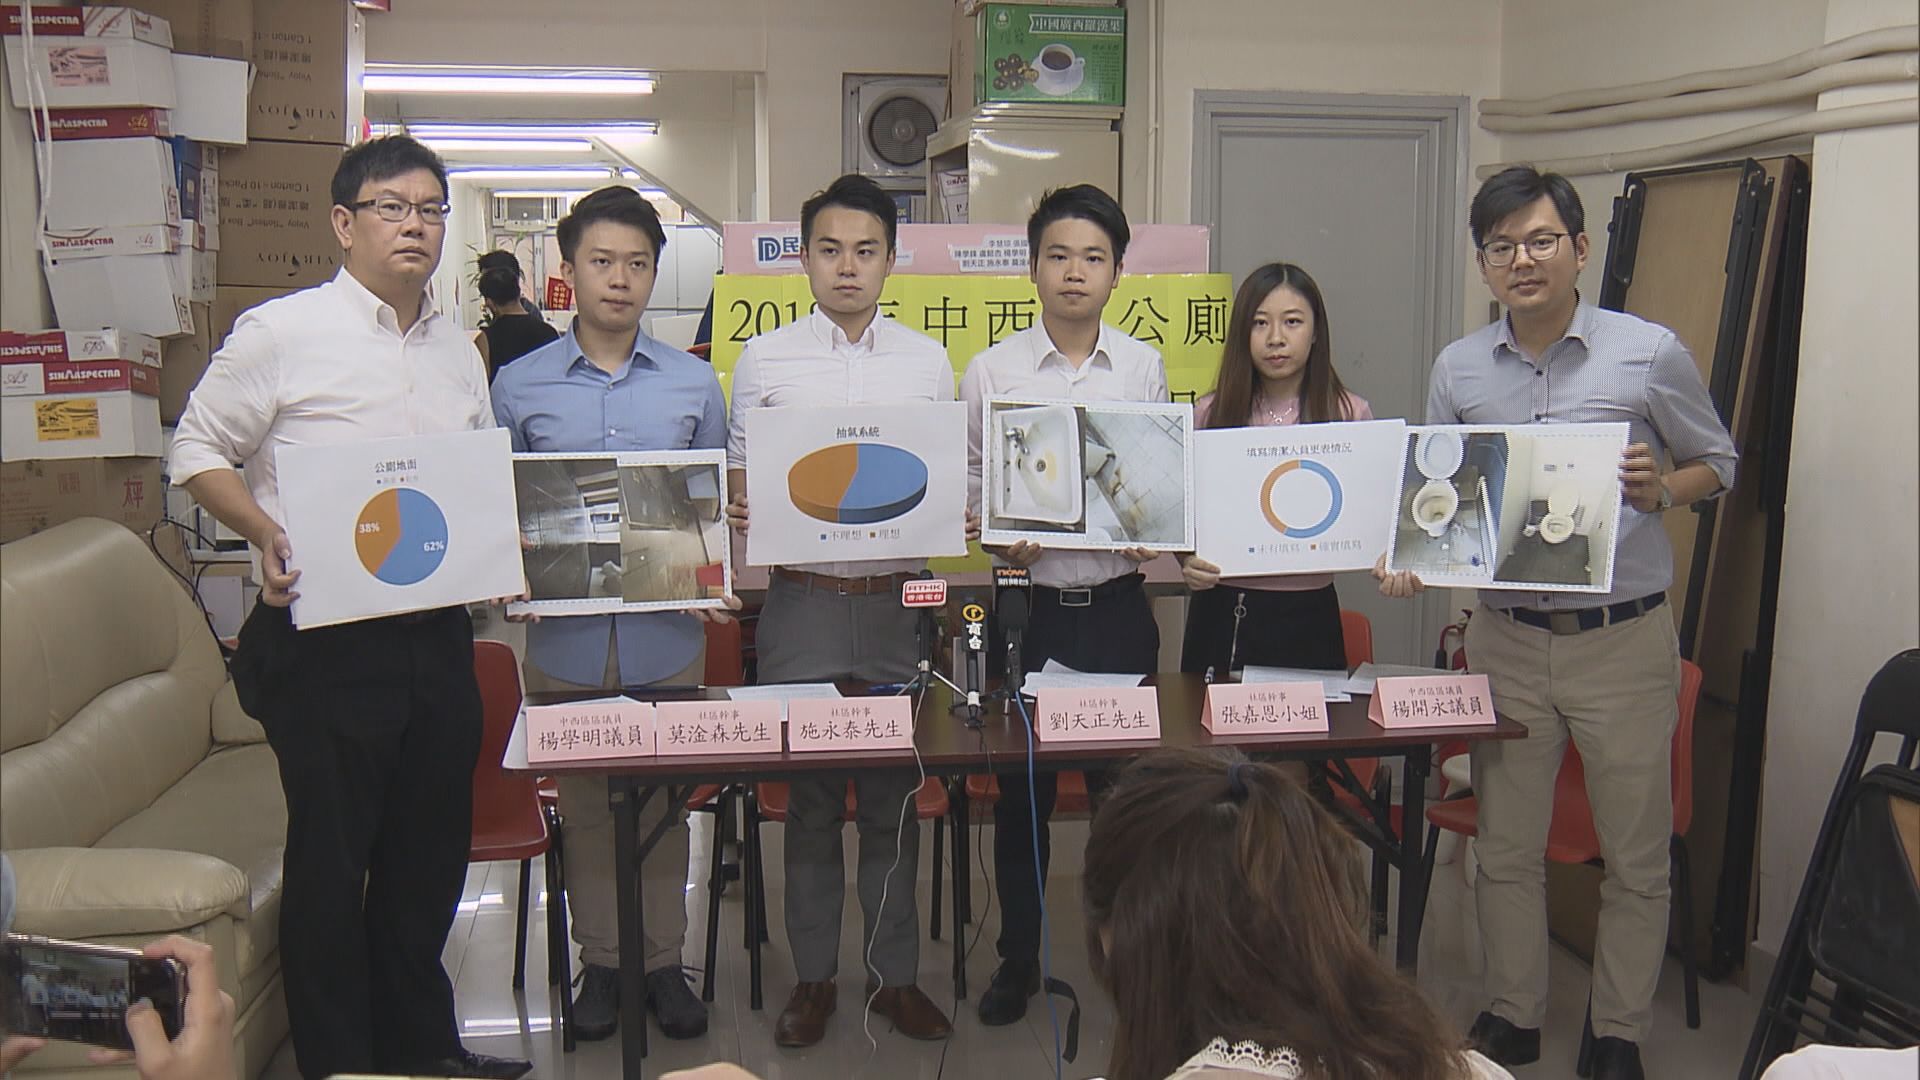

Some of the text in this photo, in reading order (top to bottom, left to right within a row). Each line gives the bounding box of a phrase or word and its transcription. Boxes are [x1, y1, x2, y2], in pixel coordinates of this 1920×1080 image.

[836, 426, 880, 438] 抽氣系統
[359, 522, 380, 534] 38%
[878, 528, 901, 540] 理想
[423, 540, 445, 552] 62%
[996, 568, 1028, 577] now
[908, 584, 942, 592] RTHK
[1221, 703, 1320, 725] 張嘉恩小姐
[1392, 696, 1484, 718] 楊開永議員
[1049, 709, 1151, 732] 劉天正先生
[537, 723, 643, 752] 楊學明議員
[667, 720, 772, 745] 莫淦森先生
[799, 719, 904, 741] 施永泰先生
